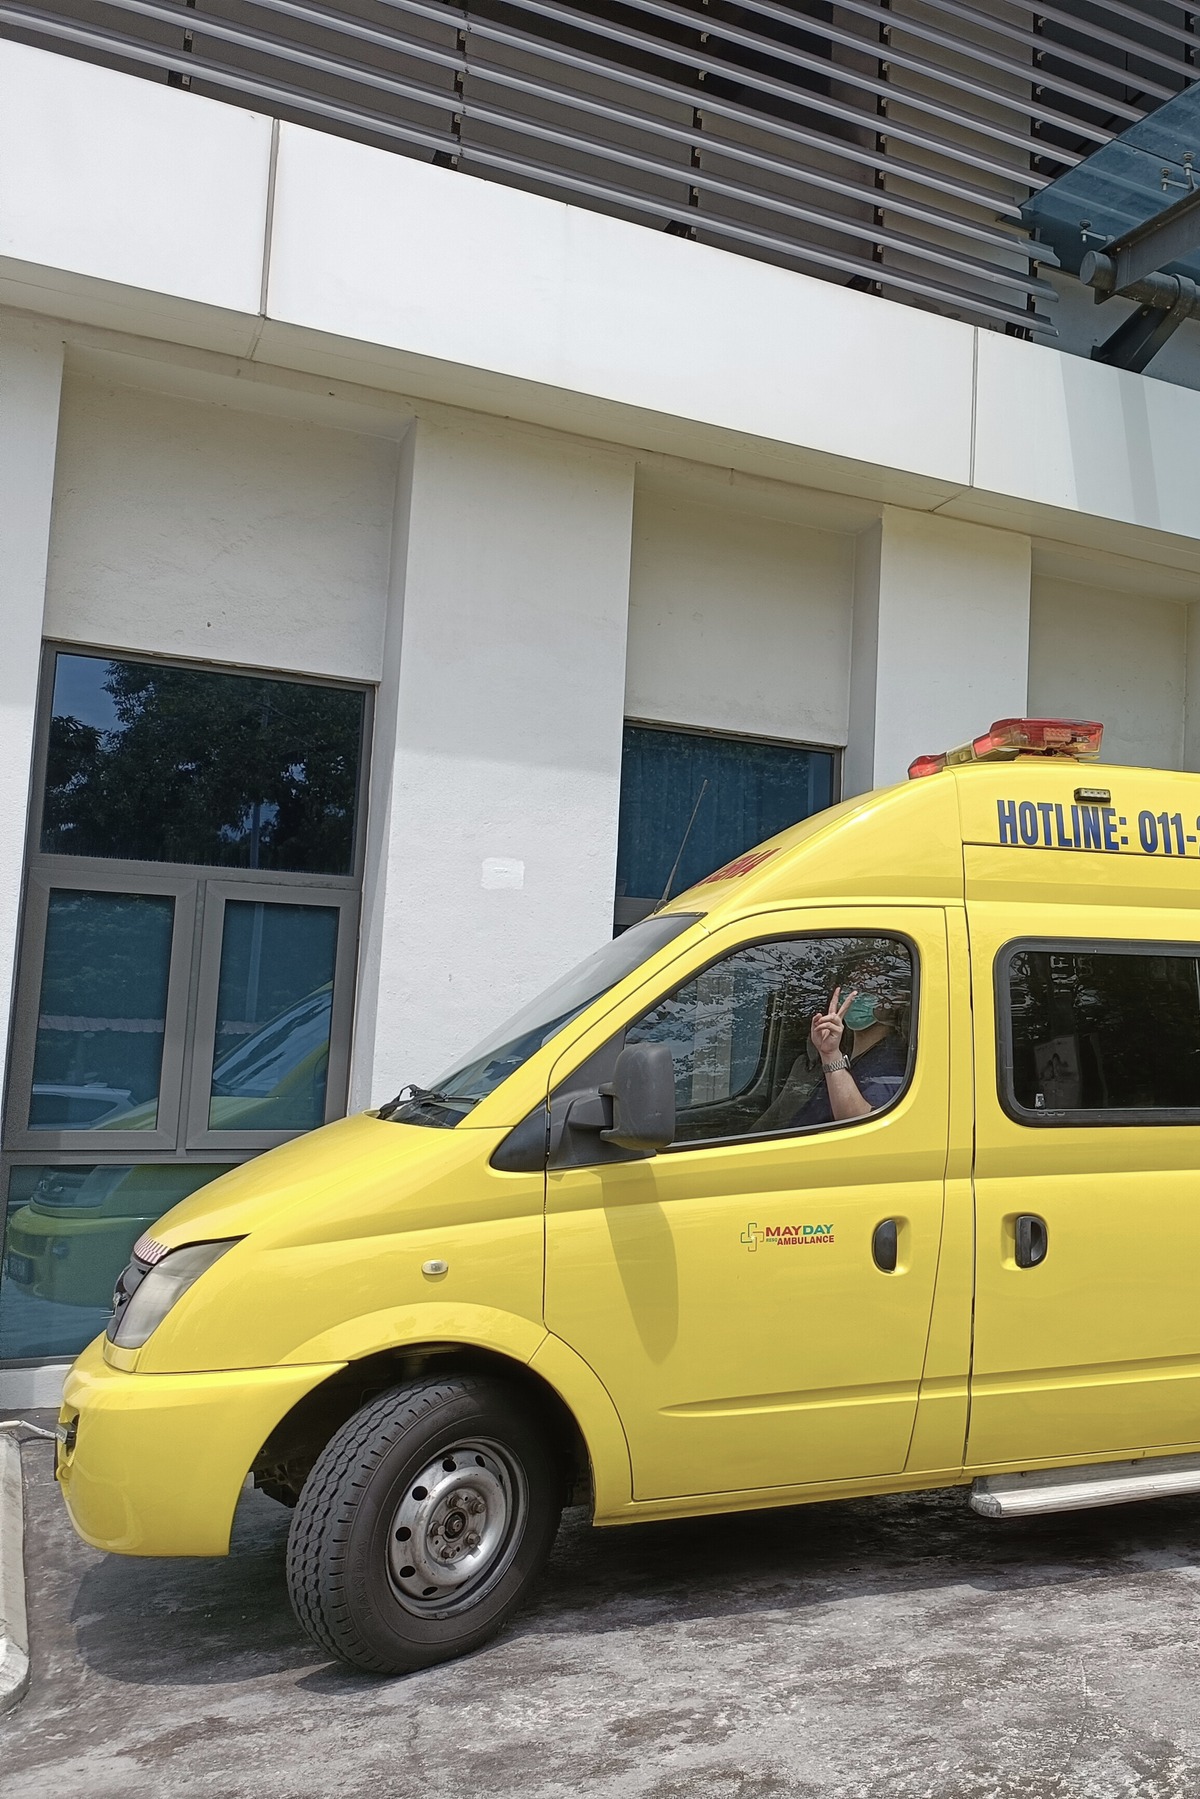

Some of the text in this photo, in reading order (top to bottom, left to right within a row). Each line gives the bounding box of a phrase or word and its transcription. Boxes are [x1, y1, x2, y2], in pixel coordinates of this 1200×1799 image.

[997, 800, 1128, 850] HOTLINE:
[766, 1224, 834, 1237] MAYDAY
[777, 1235, 834, 1246] AMBULANCE
